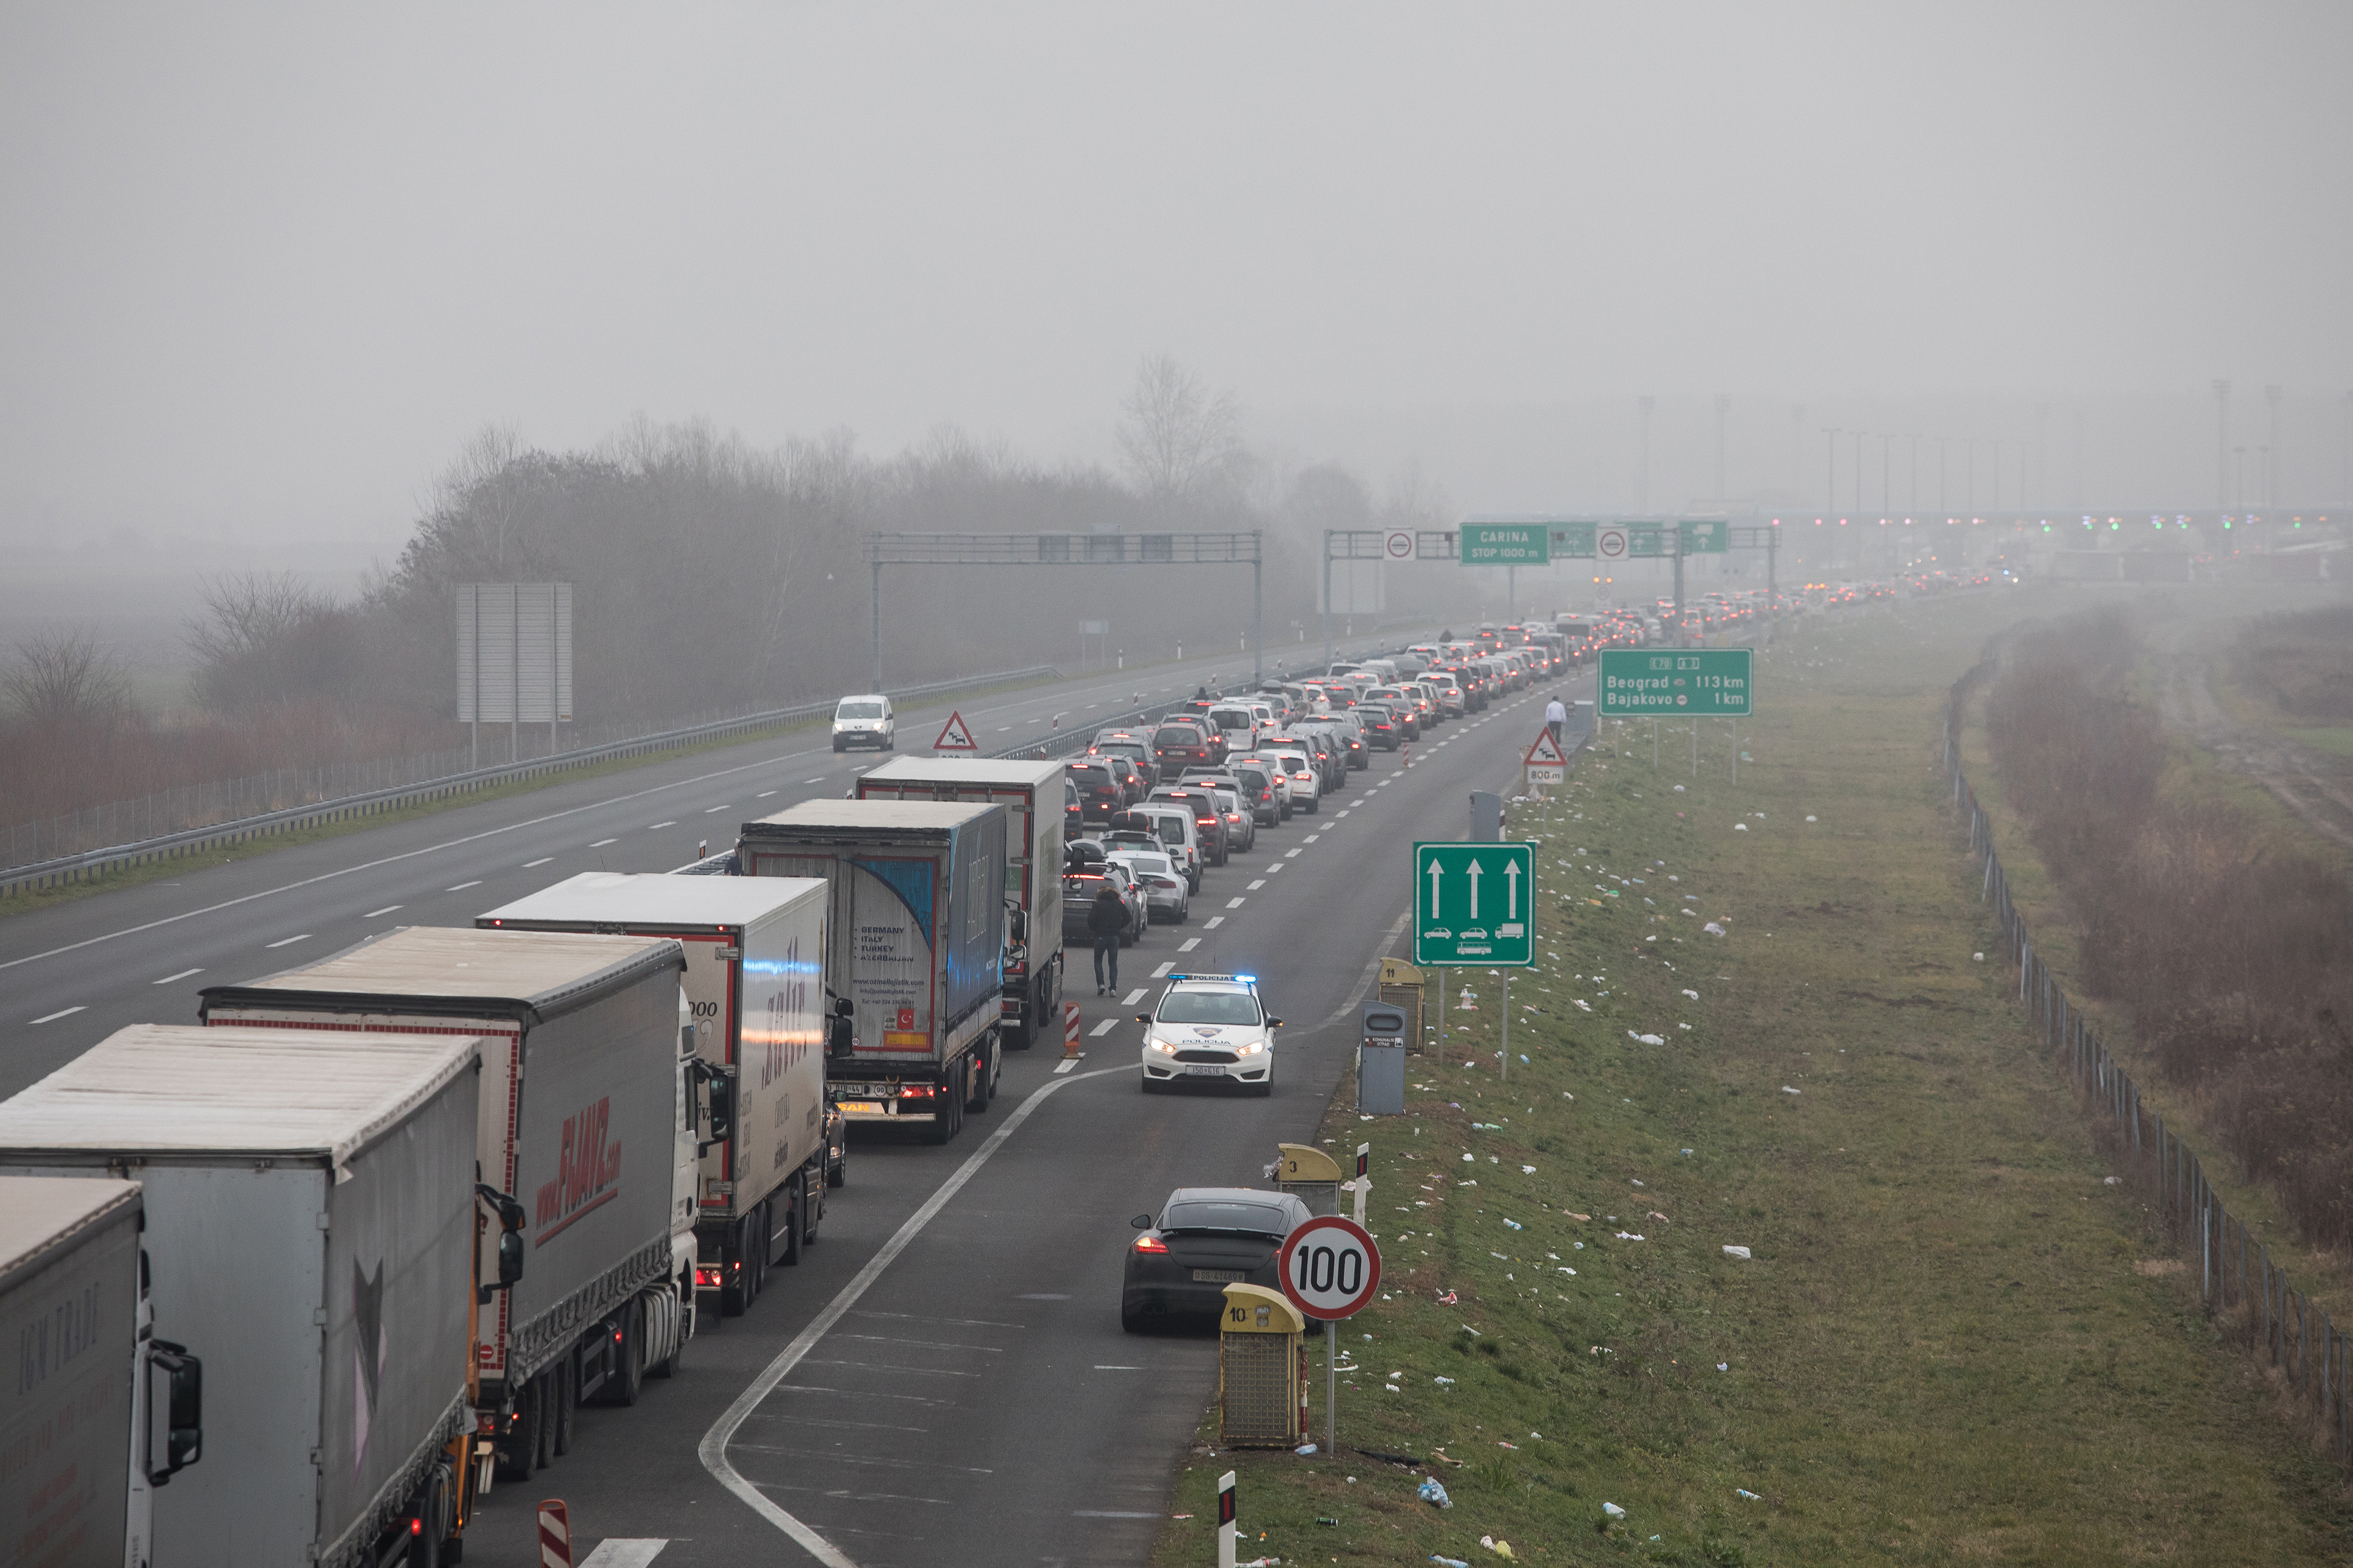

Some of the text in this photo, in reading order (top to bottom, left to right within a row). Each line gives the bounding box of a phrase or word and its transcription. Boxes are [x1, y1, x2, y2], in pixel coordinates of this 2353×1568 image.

[1480, 531, 1529, 542] CARINA
[1472, 548, 1497, 558] STOP
[1500, 548, 1525, 558] 1000
[1607, 676, 1744, 692] Beograd 113 km
[1607, 692, 1744, 708] Bajakovo 1 km
[1387, 968, 1395, 978] 11
[1289, 1160, 1297, 1173] 3
[1298, 1246, 1362, 1295] 100
[1229, 1307, 1246, 1322] 10
